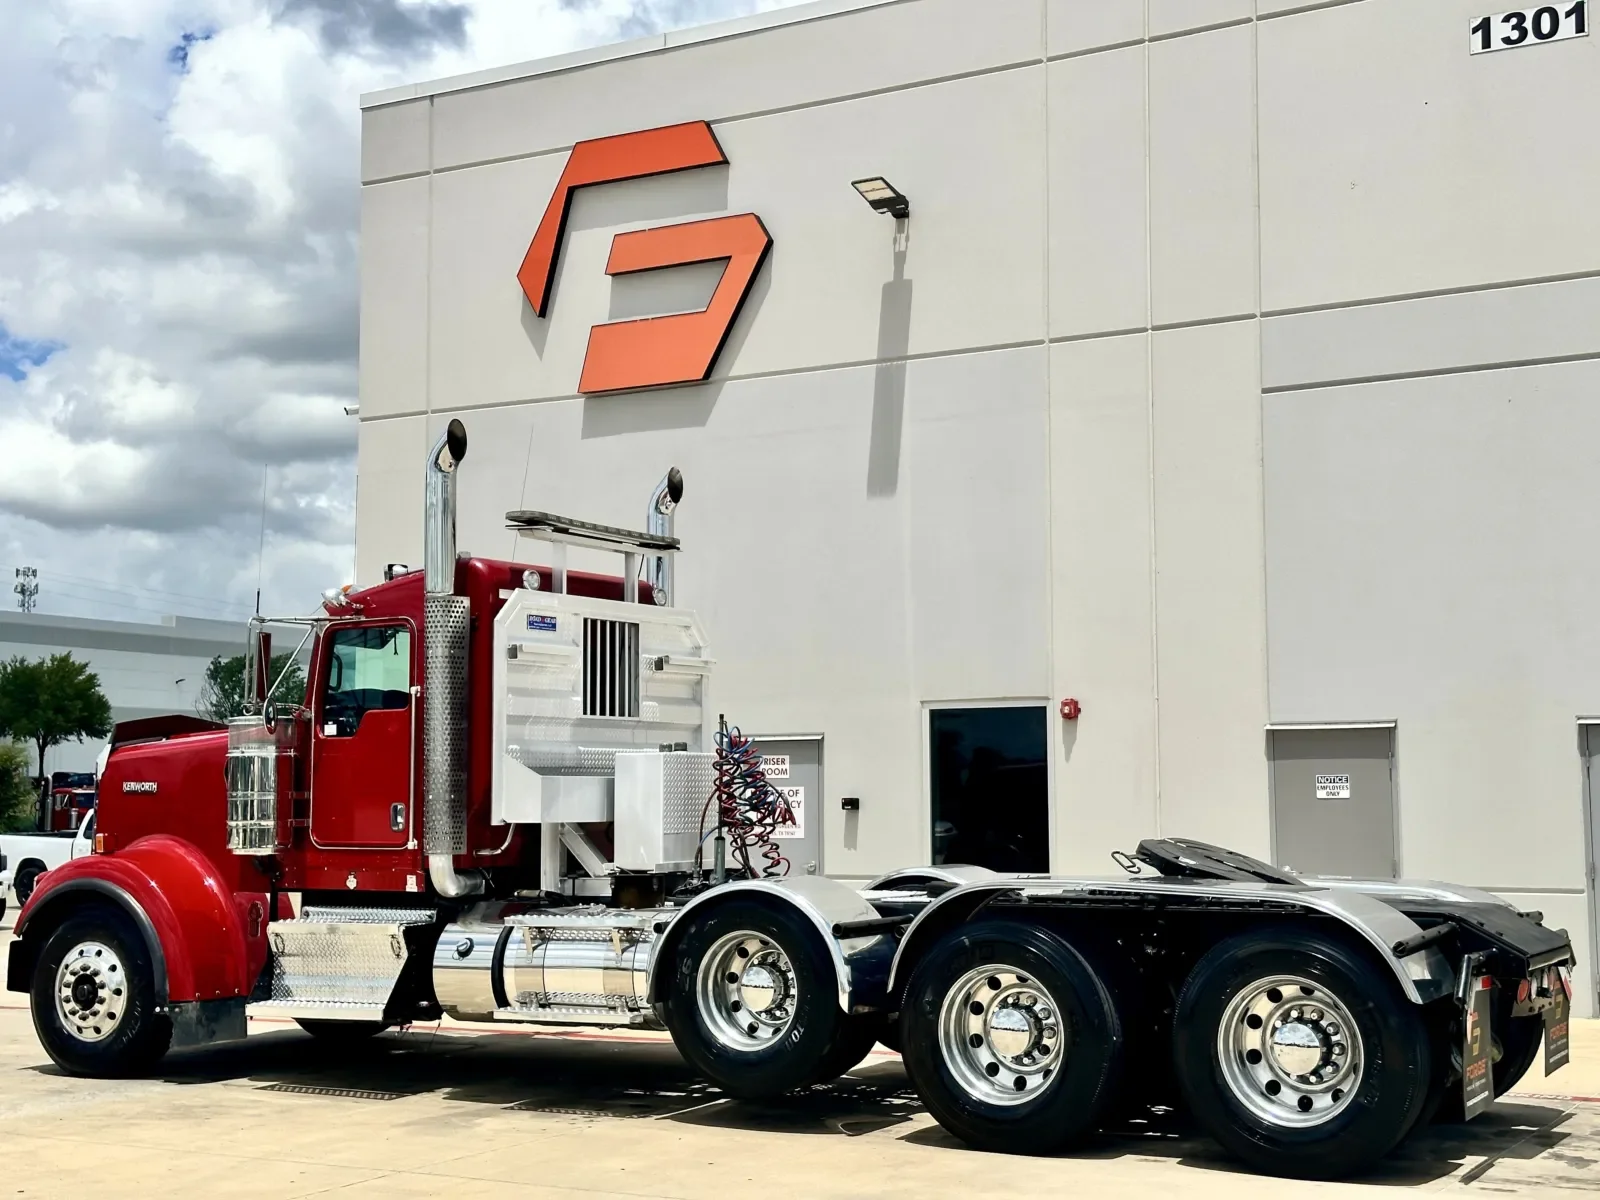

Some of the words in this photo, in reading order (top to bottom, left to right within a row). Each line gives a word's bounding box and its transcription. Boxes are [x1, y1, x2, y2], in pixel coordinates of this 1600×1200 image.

[1471, 0, 1585, 50] 1301
[763, 757, 786, 766] RISER
[1318, 776, 1348, 784] NOTICE
[122, 781, 158, 792] KENWORTH
[787, 789, 800, 798] OF
